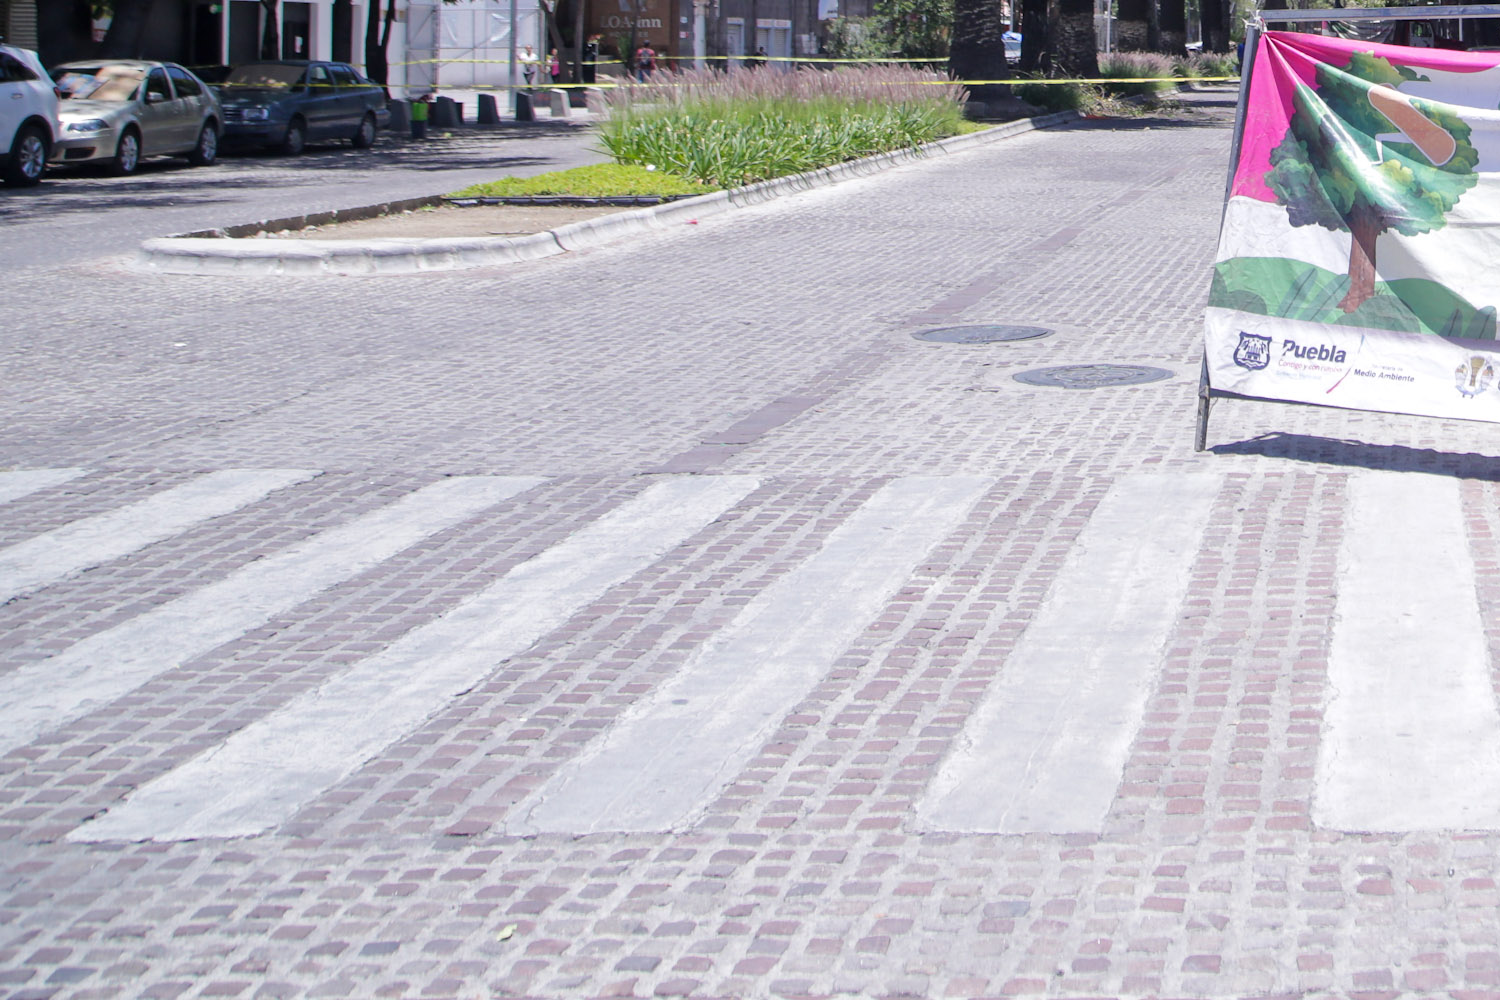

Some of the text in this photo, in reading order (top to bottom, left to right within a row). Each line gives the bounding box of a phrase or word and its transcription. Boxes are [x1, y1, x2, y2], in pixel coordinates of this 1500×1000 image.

[1282, 339, 1347, 364] Puebla
[1353, 368, 1415, 383] Medio Ambiente
